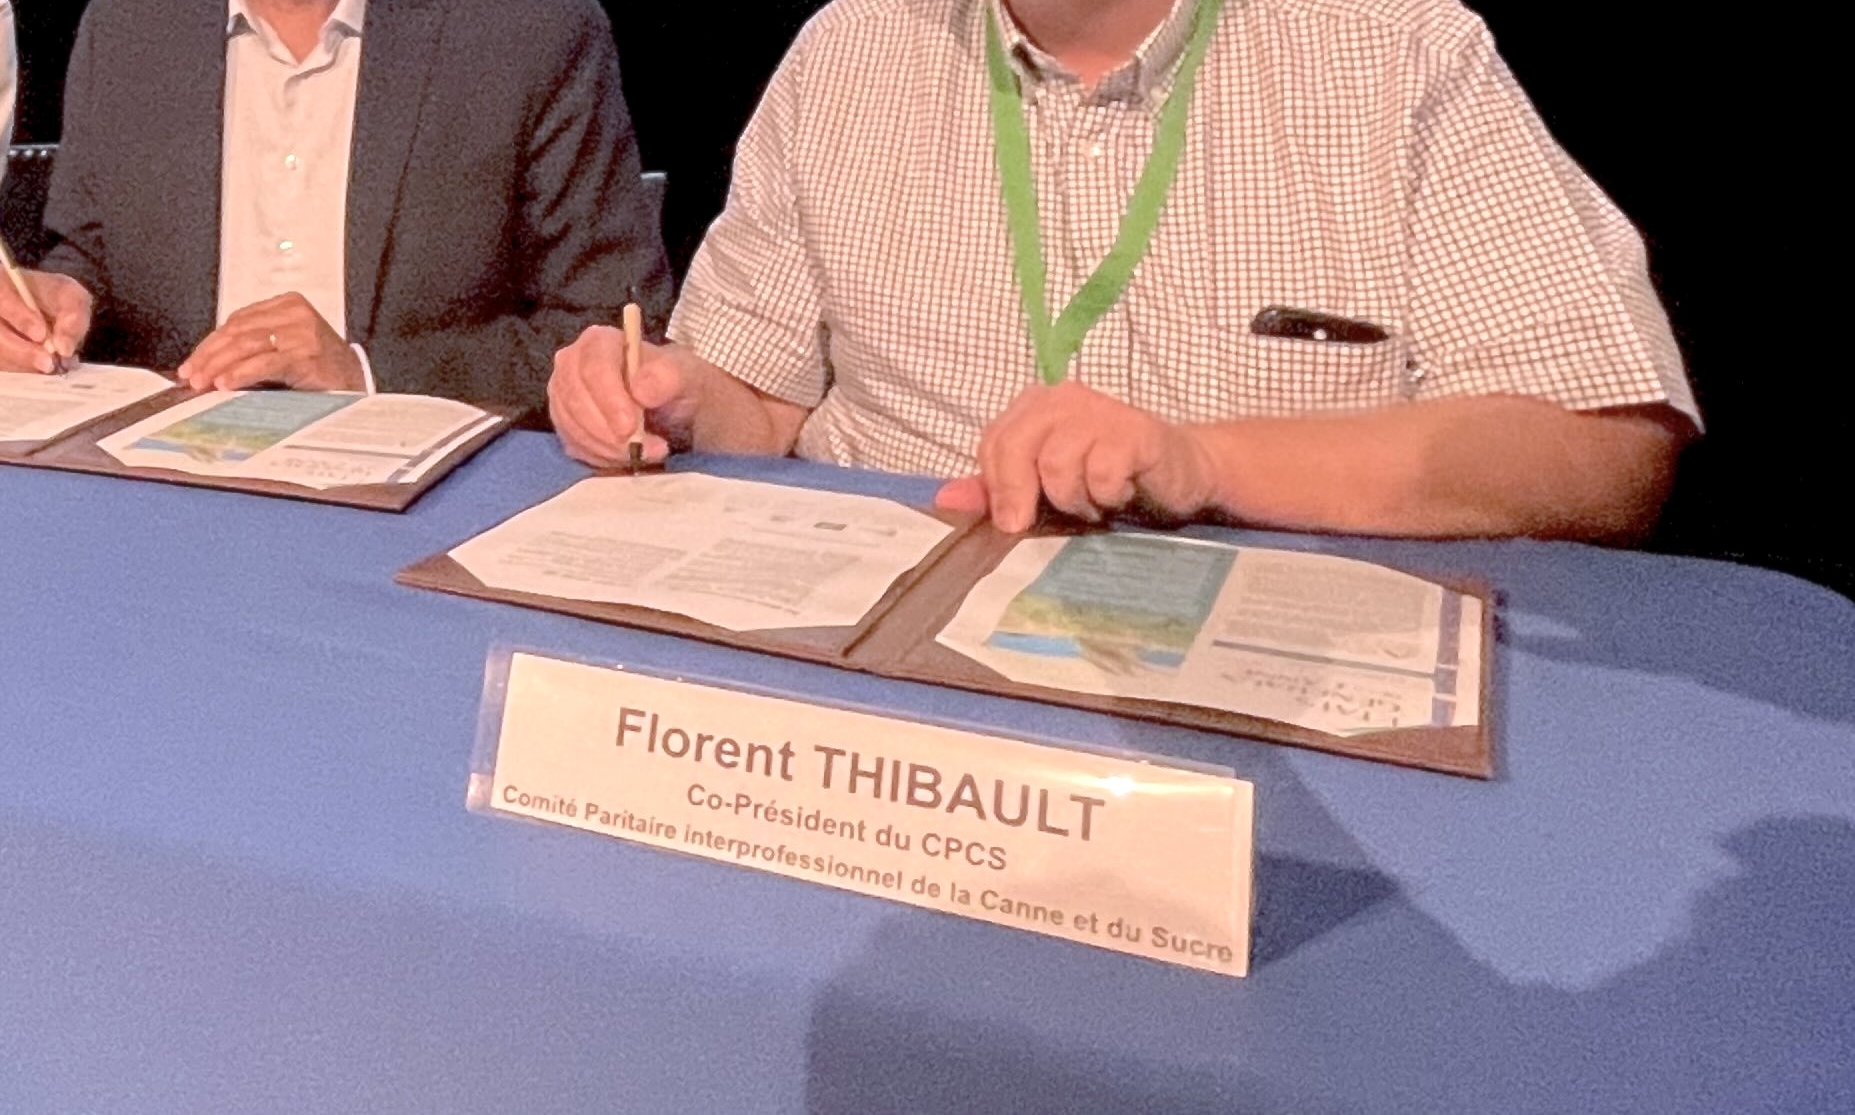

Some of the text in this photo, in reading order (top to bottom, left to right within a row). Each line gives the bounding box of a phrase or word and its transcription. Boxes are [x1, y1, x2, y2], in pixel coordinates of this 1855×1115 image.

[615, 707, 1106, 841] Florent THIBAULT
[687, 783, 1007, 871] Co-Président du CPCS
[503, 785, 1233, 964] Comité Paritaire interprofessionnel de la Canne et du Sucre
